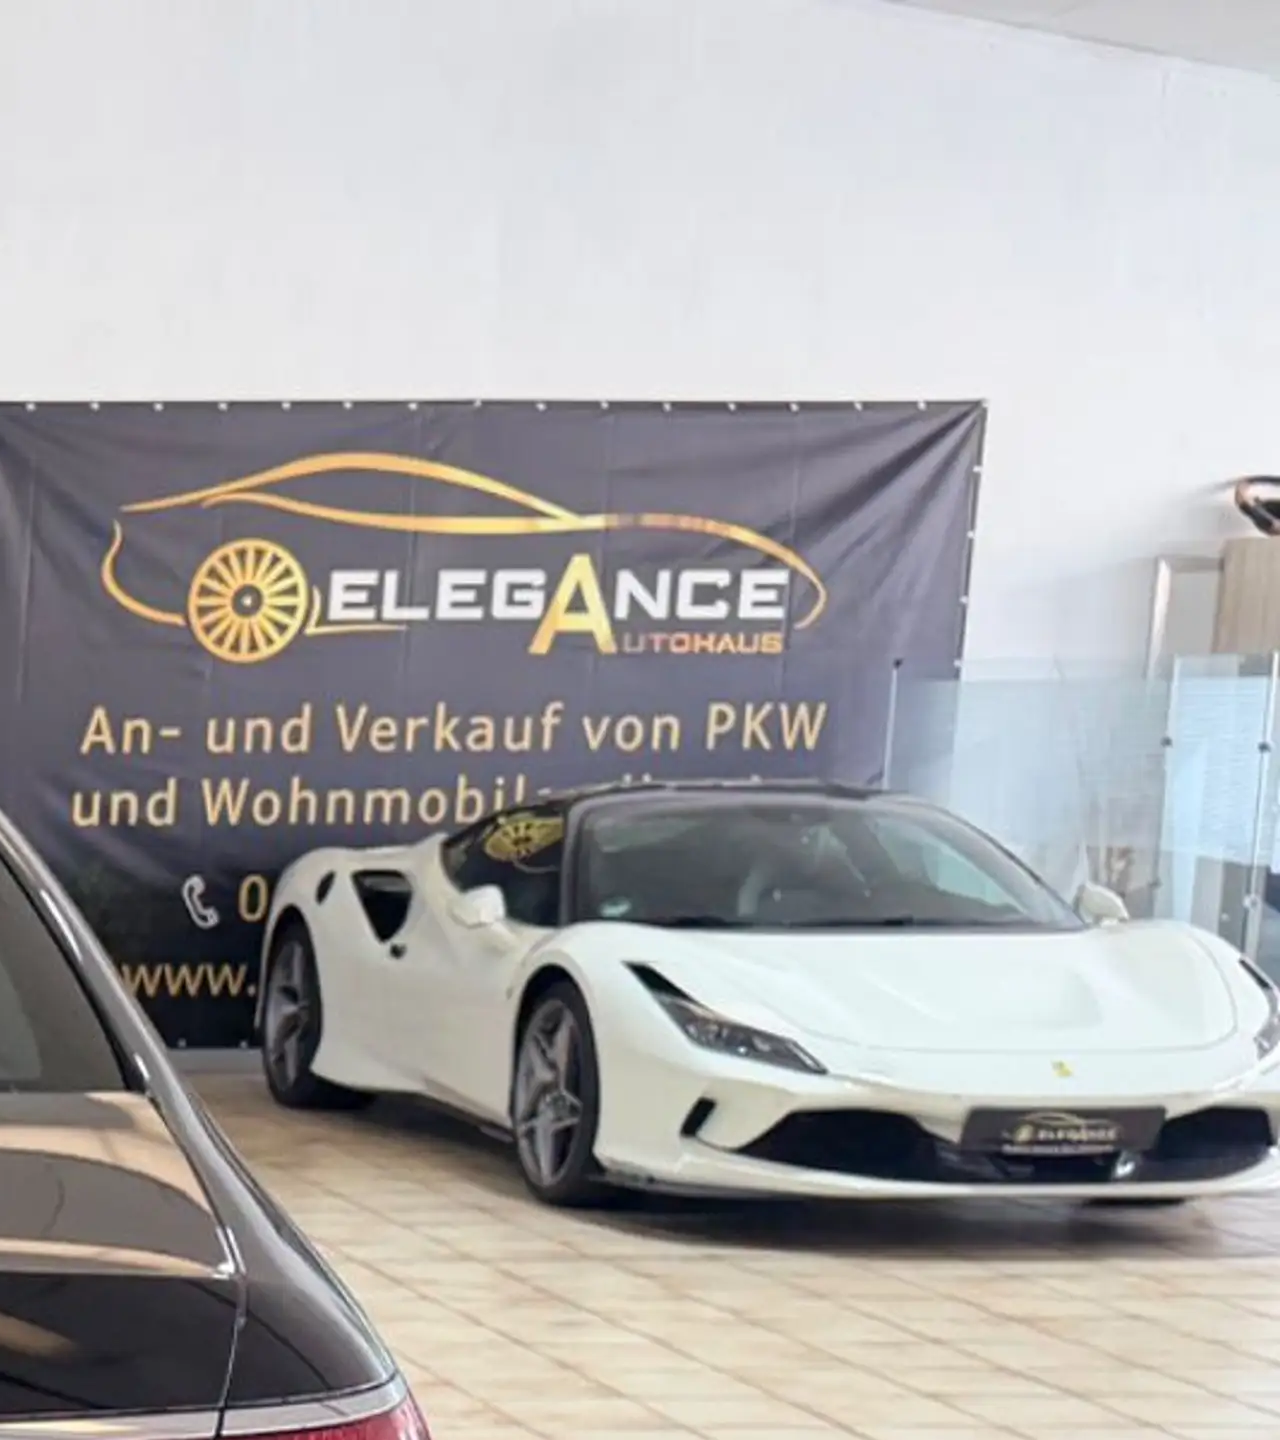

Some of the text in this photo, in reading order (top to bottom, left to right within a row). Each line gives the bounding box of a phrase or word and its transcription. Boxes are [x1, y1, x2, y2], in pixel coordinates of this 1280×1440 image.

[327, 553, 790, 655] ELEGANCE
[80, 700, 828, 754] An- und Verkauf von PKW
[71, 773, 551, 827] und Wohnmobil
